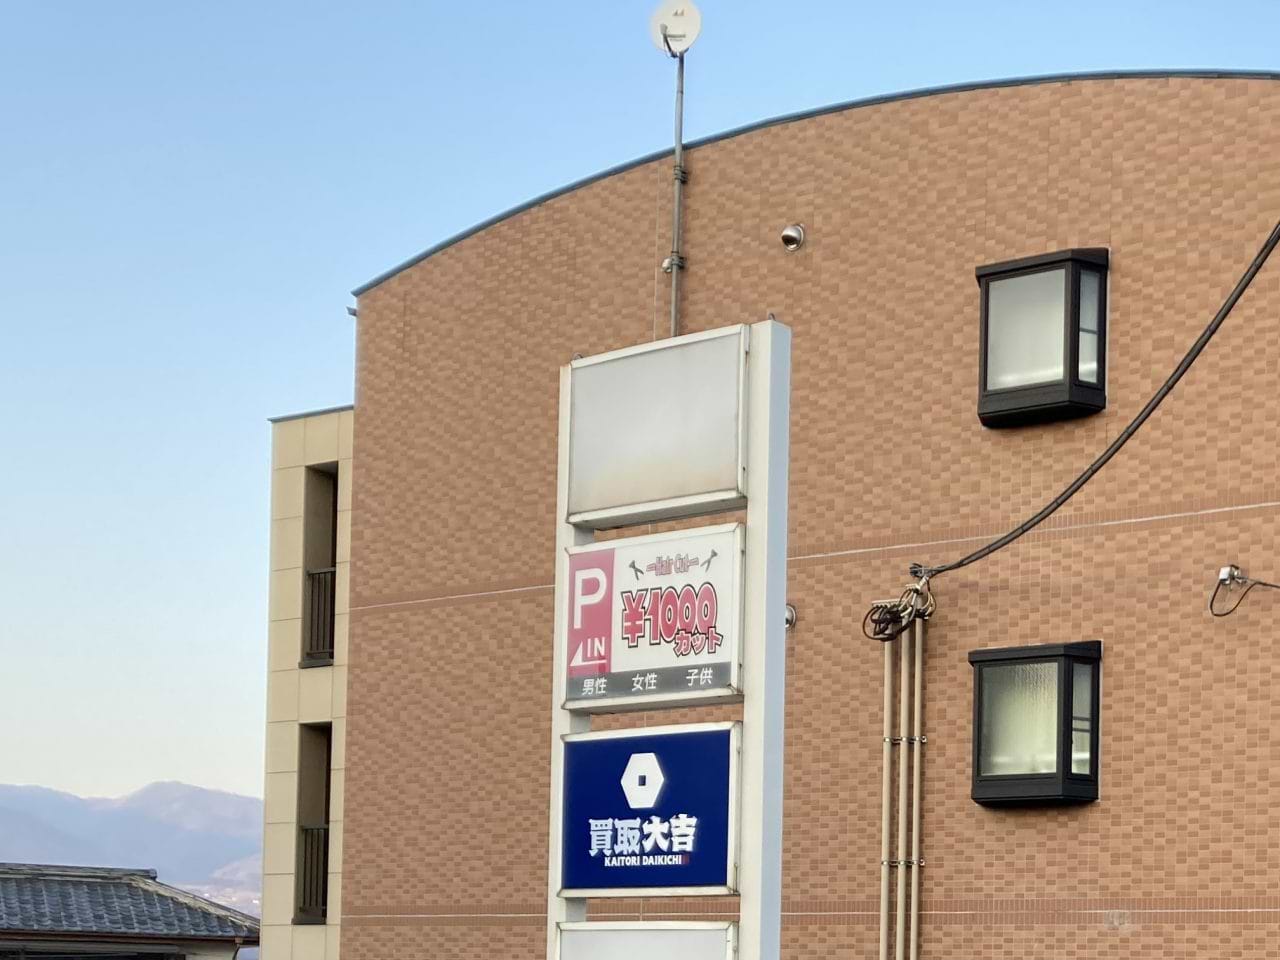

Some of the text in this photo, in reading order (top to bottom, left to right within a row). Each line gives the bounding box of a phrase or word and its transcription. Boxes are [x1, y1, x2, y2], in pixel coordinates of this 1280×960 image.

[656, 553, 689, 576] Hair Cut
[573, 567, 607, 630] P
[621, 582, 718, 648] ¥1000
[586, 636, 606, 658] IN
[674, 626, 724, 657] カット
[582, 677, 607, 696] 男性
[631, 672, 657, 692] 女性
[686, 668, 713, 687] 子供
[588, 813, 698, 857] 買取大吉
[604, 854, 682, 867] KAITORI DAIKICHI
